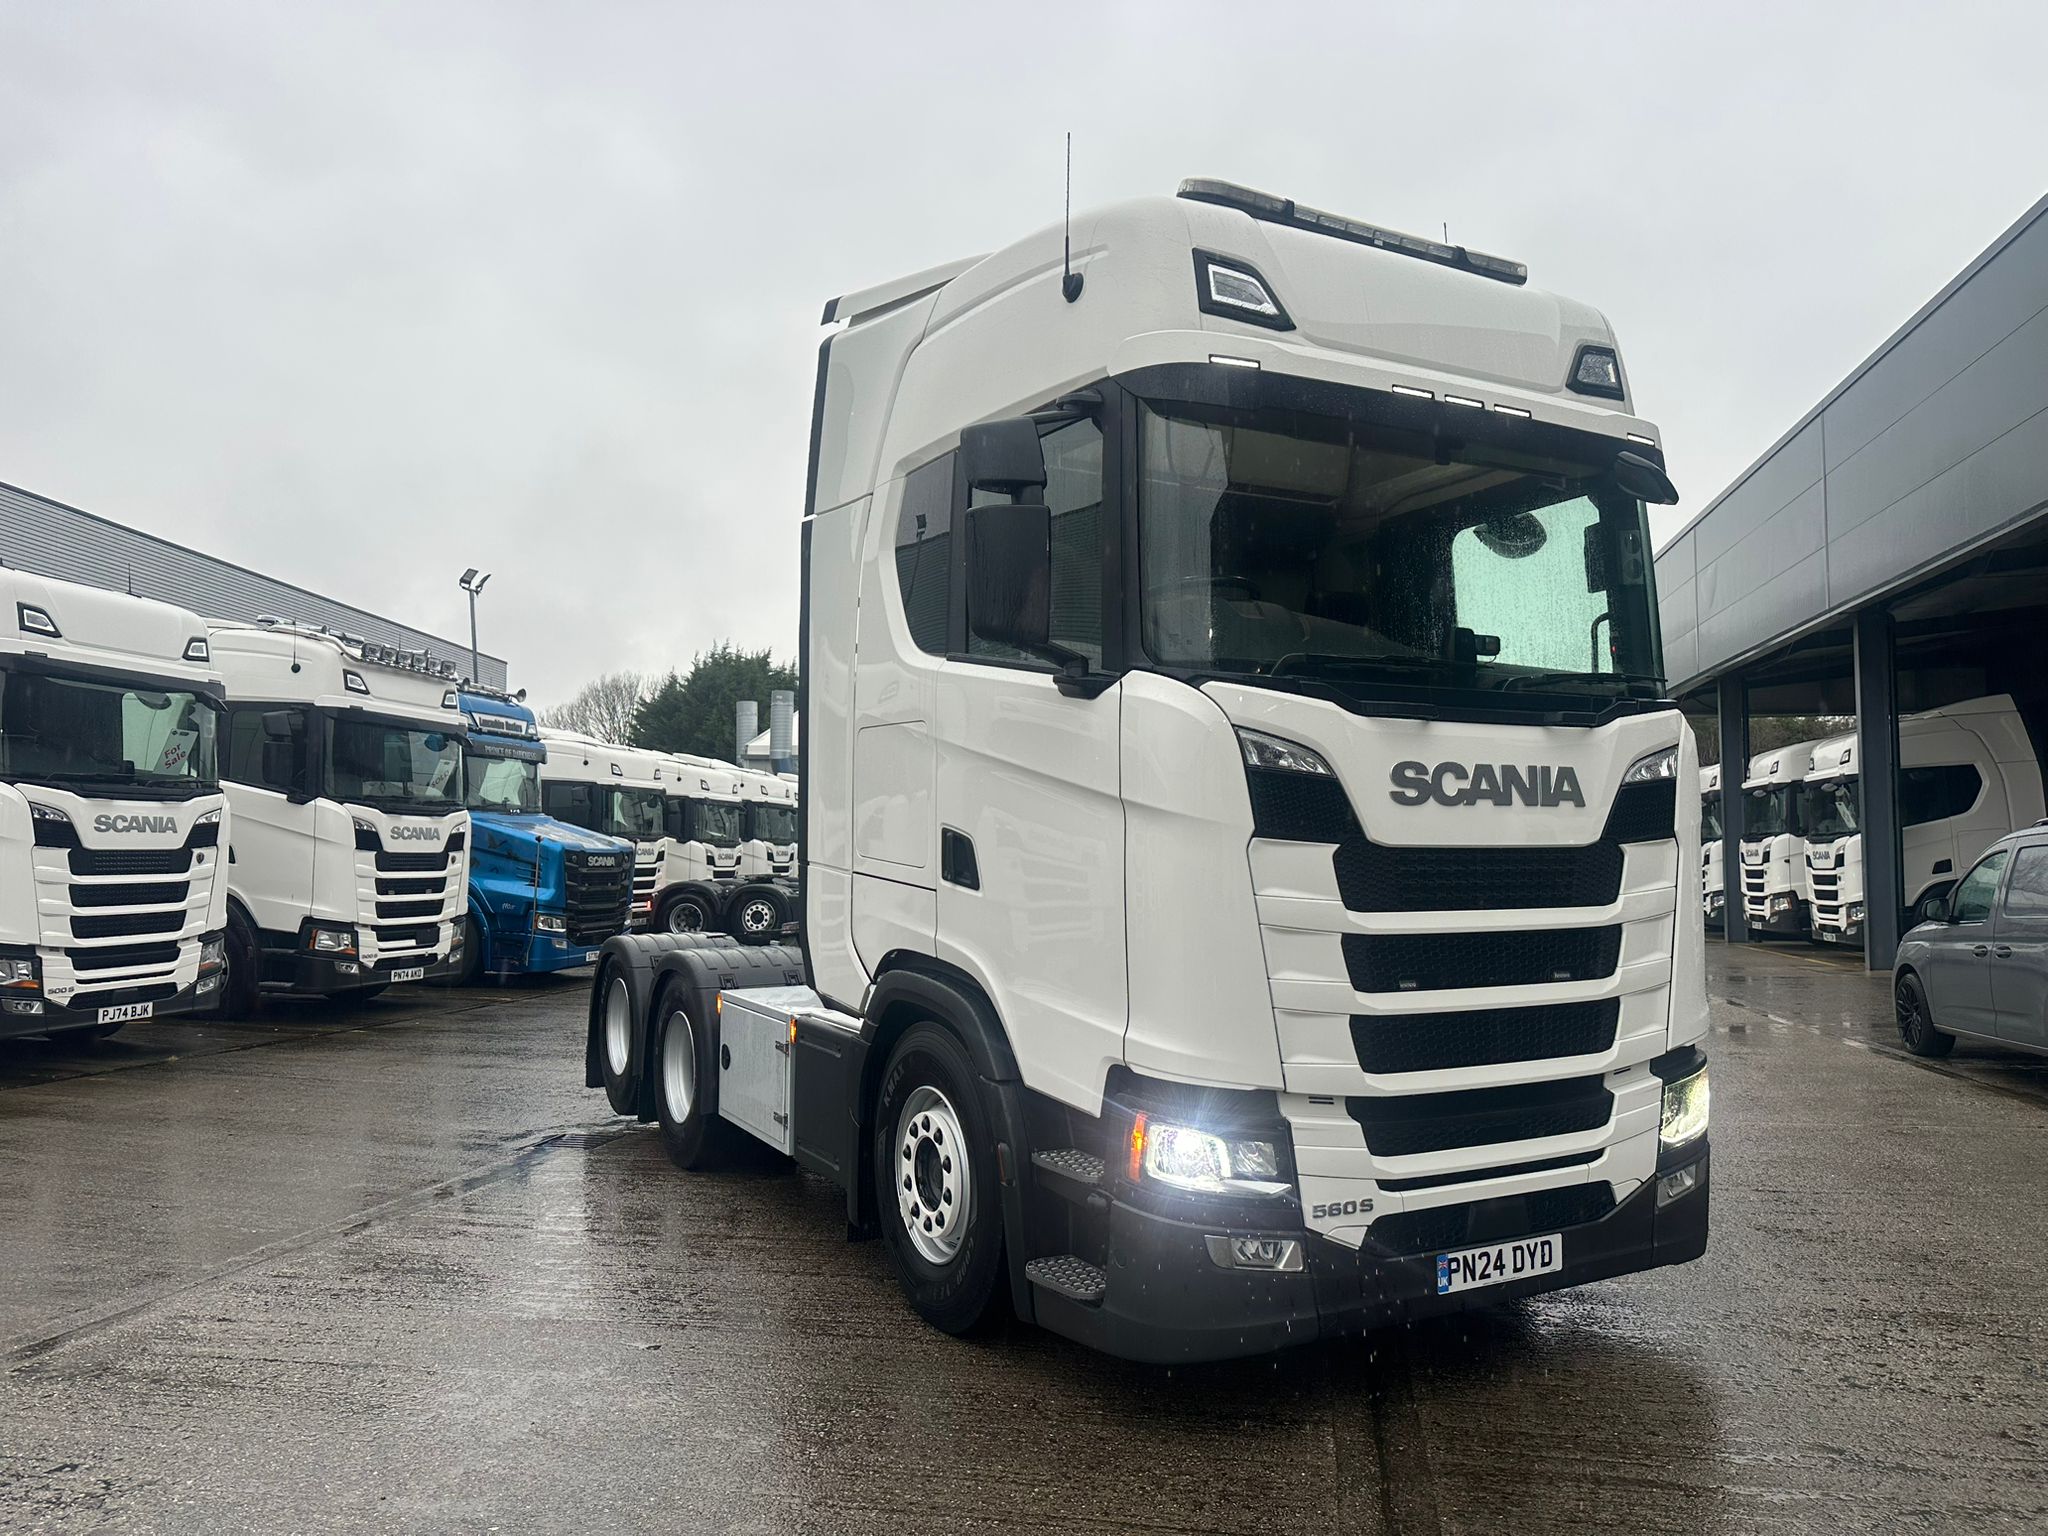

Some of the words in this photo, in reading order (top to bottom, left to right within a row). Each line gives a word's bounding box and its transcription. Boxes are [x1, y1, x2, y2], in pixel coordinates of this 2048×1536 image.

[164, 744, 181, 759] For
[165, 751, 186, 769] Sale
[1389, 761, 1586, 807] SCANIA
[94, 814, 178, 834] SCANIA
[391, 825, 441, 841] SCANIA
[587, 855, 616, 867] SCANIA
[393, 970, 410, 981] PN74
[102, 1007, 128, 1022] PJ74
[130, 1004, 150, 1018] BJK
[1447, 1248, 1506, 1287] PN24
[1511, 1239, 1553, 1274] DYD
[1438, 1276, 1449, 1288] UK
